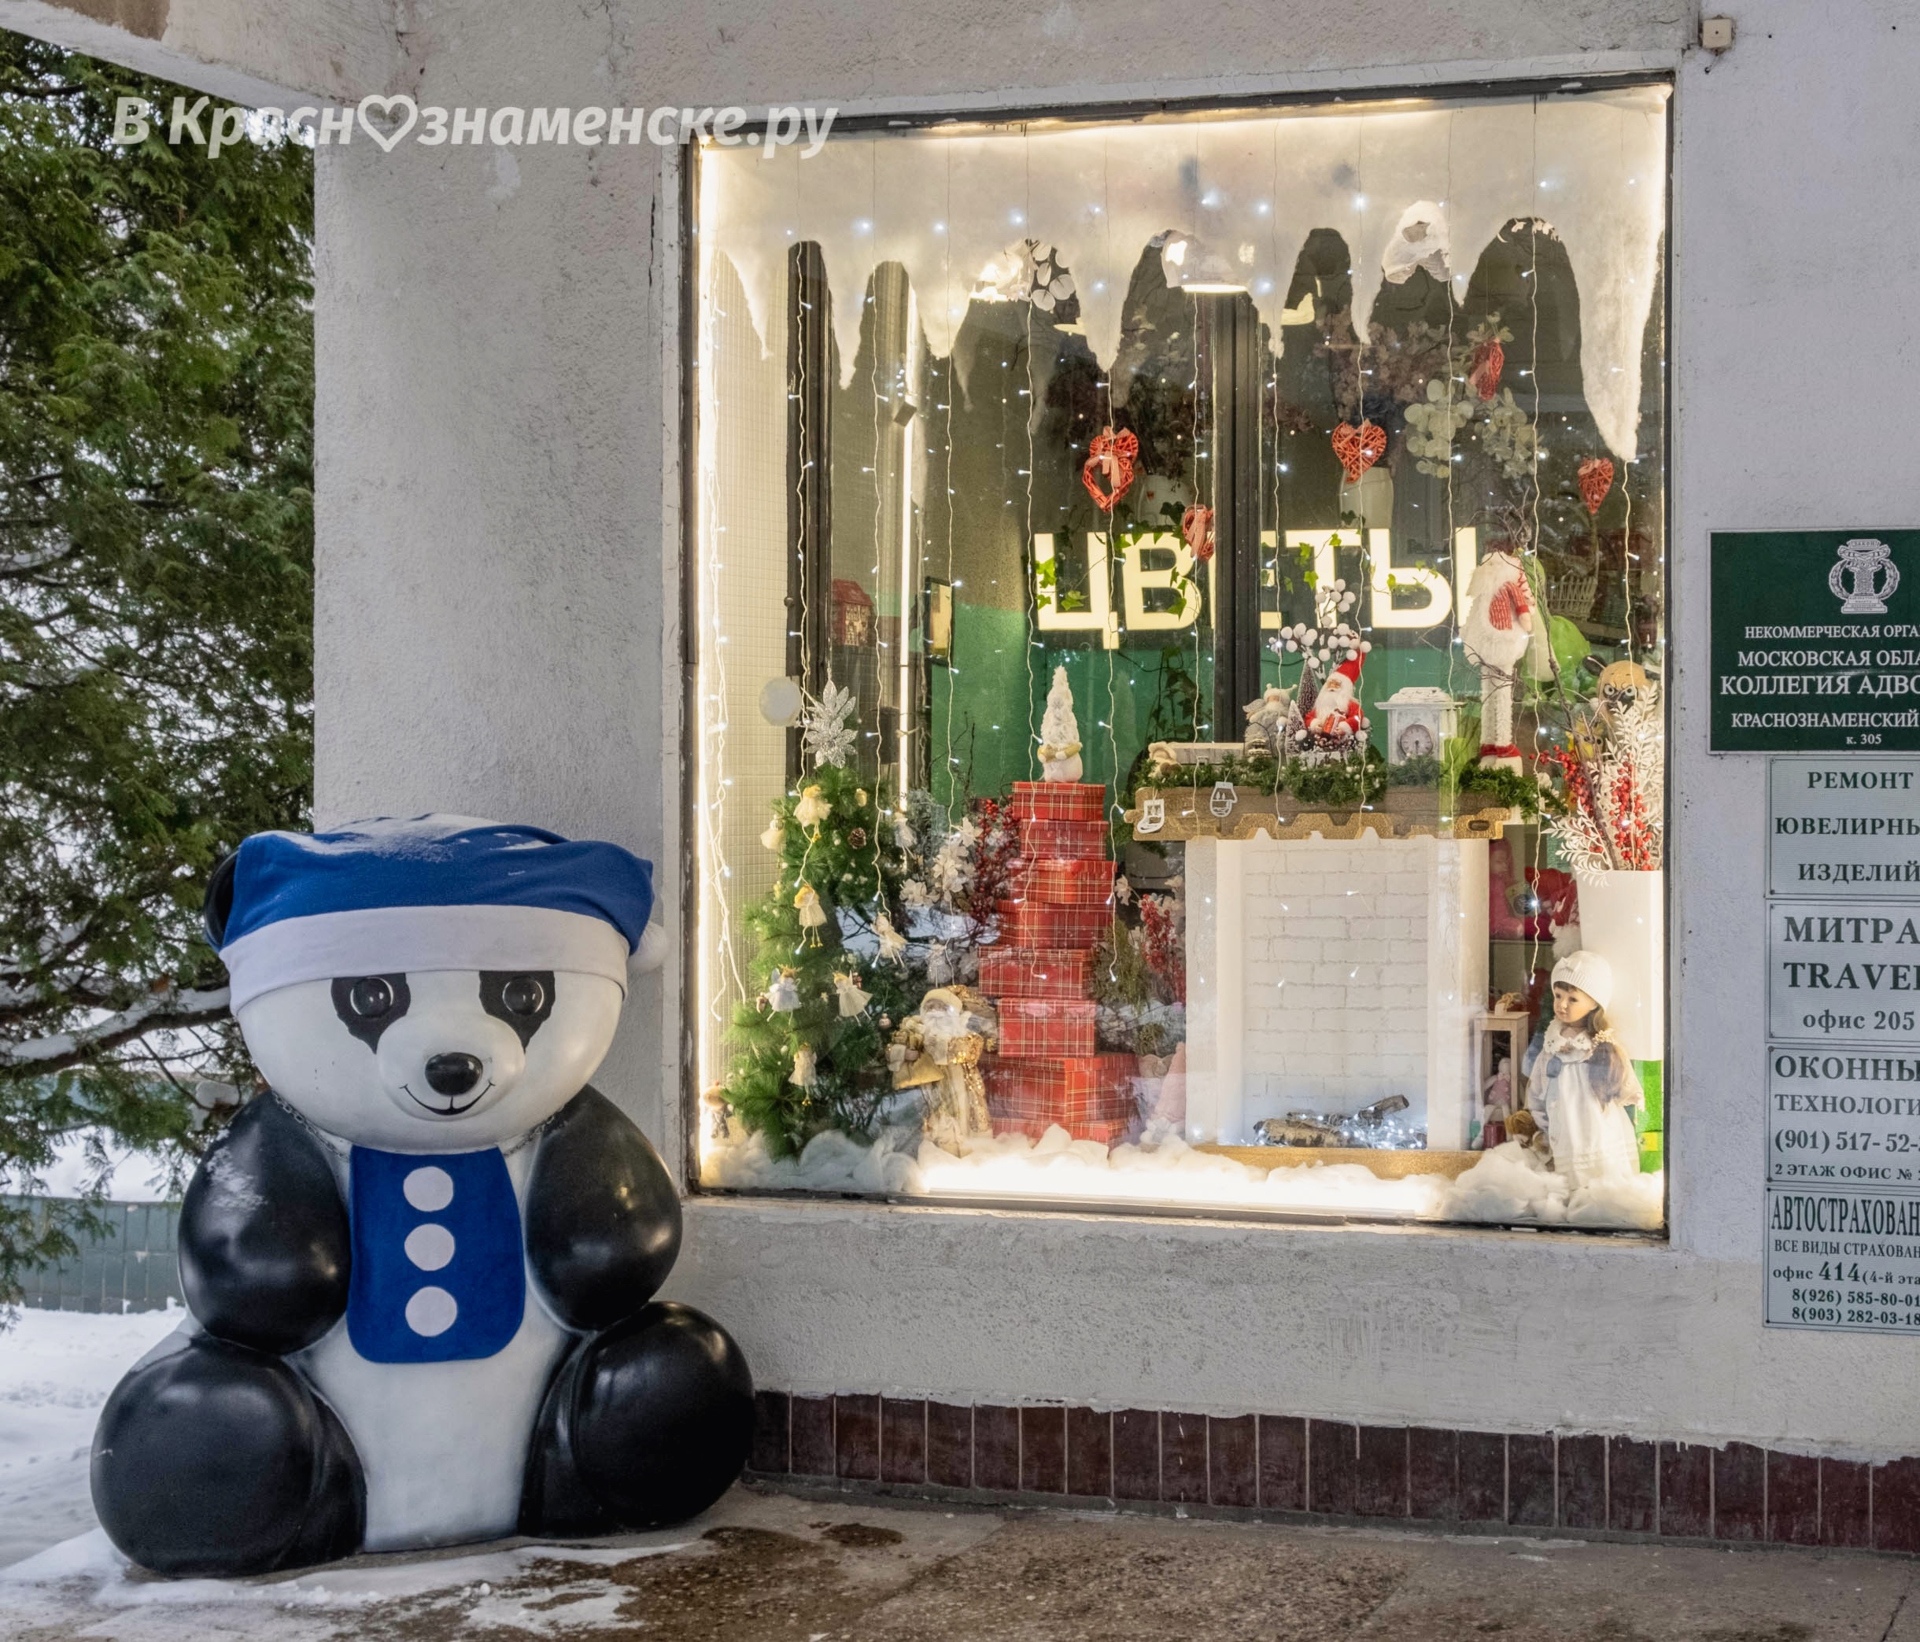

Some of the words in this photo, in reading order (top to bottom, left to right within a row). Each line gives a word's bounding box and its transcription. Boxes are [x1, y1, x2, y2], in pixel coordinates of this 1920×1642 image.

[1745, 625, 1880, 639] НЕКОММЕРЧЕСКАЯ
[1884, 624, 1920, 638] ОРГА
[1738, 650, 1871, 667] МОСКОВСКАЯ
[1720, 675, 1851, 695] КОЛЛЕГИЯ
[1731, 709, 1919, 728] КРАСНОЗНАМЕНСКИЙ
[1846, 735, 1857, 745] к.
[1860, 734, 1882, 745] 305
[1807, 771, 1913, 790] РЕМОНТ
[1797, 860, 1920, 885] ИЗДЕЛИЙ
[1783, 916, 1920, 944] МИТРА
[1803, 1009, 1865, 1033] офис
[1873, 1010, 1915, 1031] 205
[1775, 1094, 1920, 1116] ТЕХНОЛОГИ
[1774, 1129, 1830, 1154] (901)
[1885, 1133, 1920, 1153] 52-
[1774, 1163, 1783, 1176] 2
[1787, 1164, 1835, 1178] ЭТАЖ
[1840, 1165, 1892, 1180] ОФИС
[1896, 1168, 1913, 1181] №
[1771, 1195, 1920, 1237] АВТОСТРАХОВАН
[1774, 1239, 1799, 1253] ВСЕ
[1802, 1241, 1841, 1256] ВИДЫ
[1843, 1242, 1920, 1259] СТРАХОВАН
[1773, 1266, 1813, 1282] офис
[1819, 1260, 1861, 1282] 414
[1862, 1269, 1894, 1286] (4-й
[1792, 1288, 1842, 1307] 8(926)
[1847, 1290, 1920, 1308] 585-80-01
[1792, 1307, 1842, 1324] 8(903)
[1847, 1309, 1920, 1326] 282-03-18
